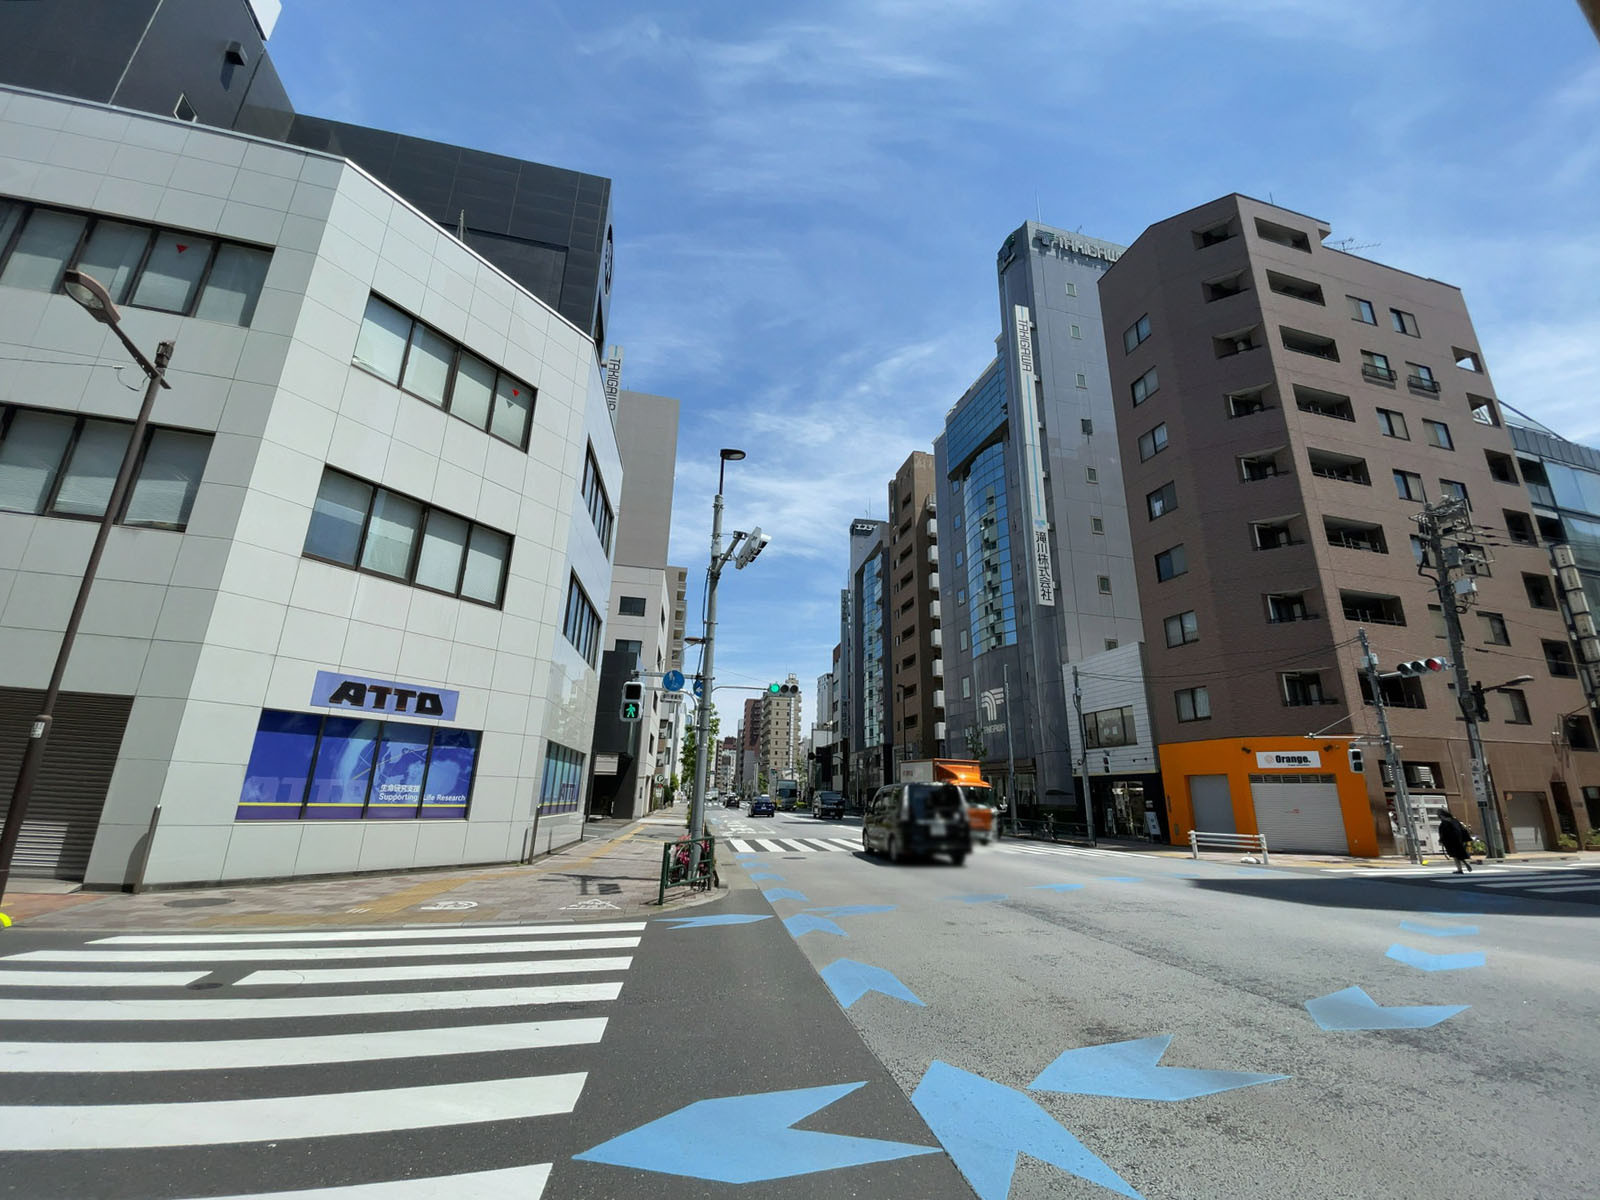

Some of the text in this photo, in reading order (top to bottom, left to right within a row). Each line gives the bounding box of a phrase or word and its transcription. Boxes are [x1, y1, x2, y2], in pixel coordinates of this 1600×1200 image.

[1018, 319, 1033, 373] TAKIGAWA
[1035, 531, 1053, 601] 滝川株式会社
[329, 680, 444, 716] ATTO
[378, 793, 418, 802] Supporting
